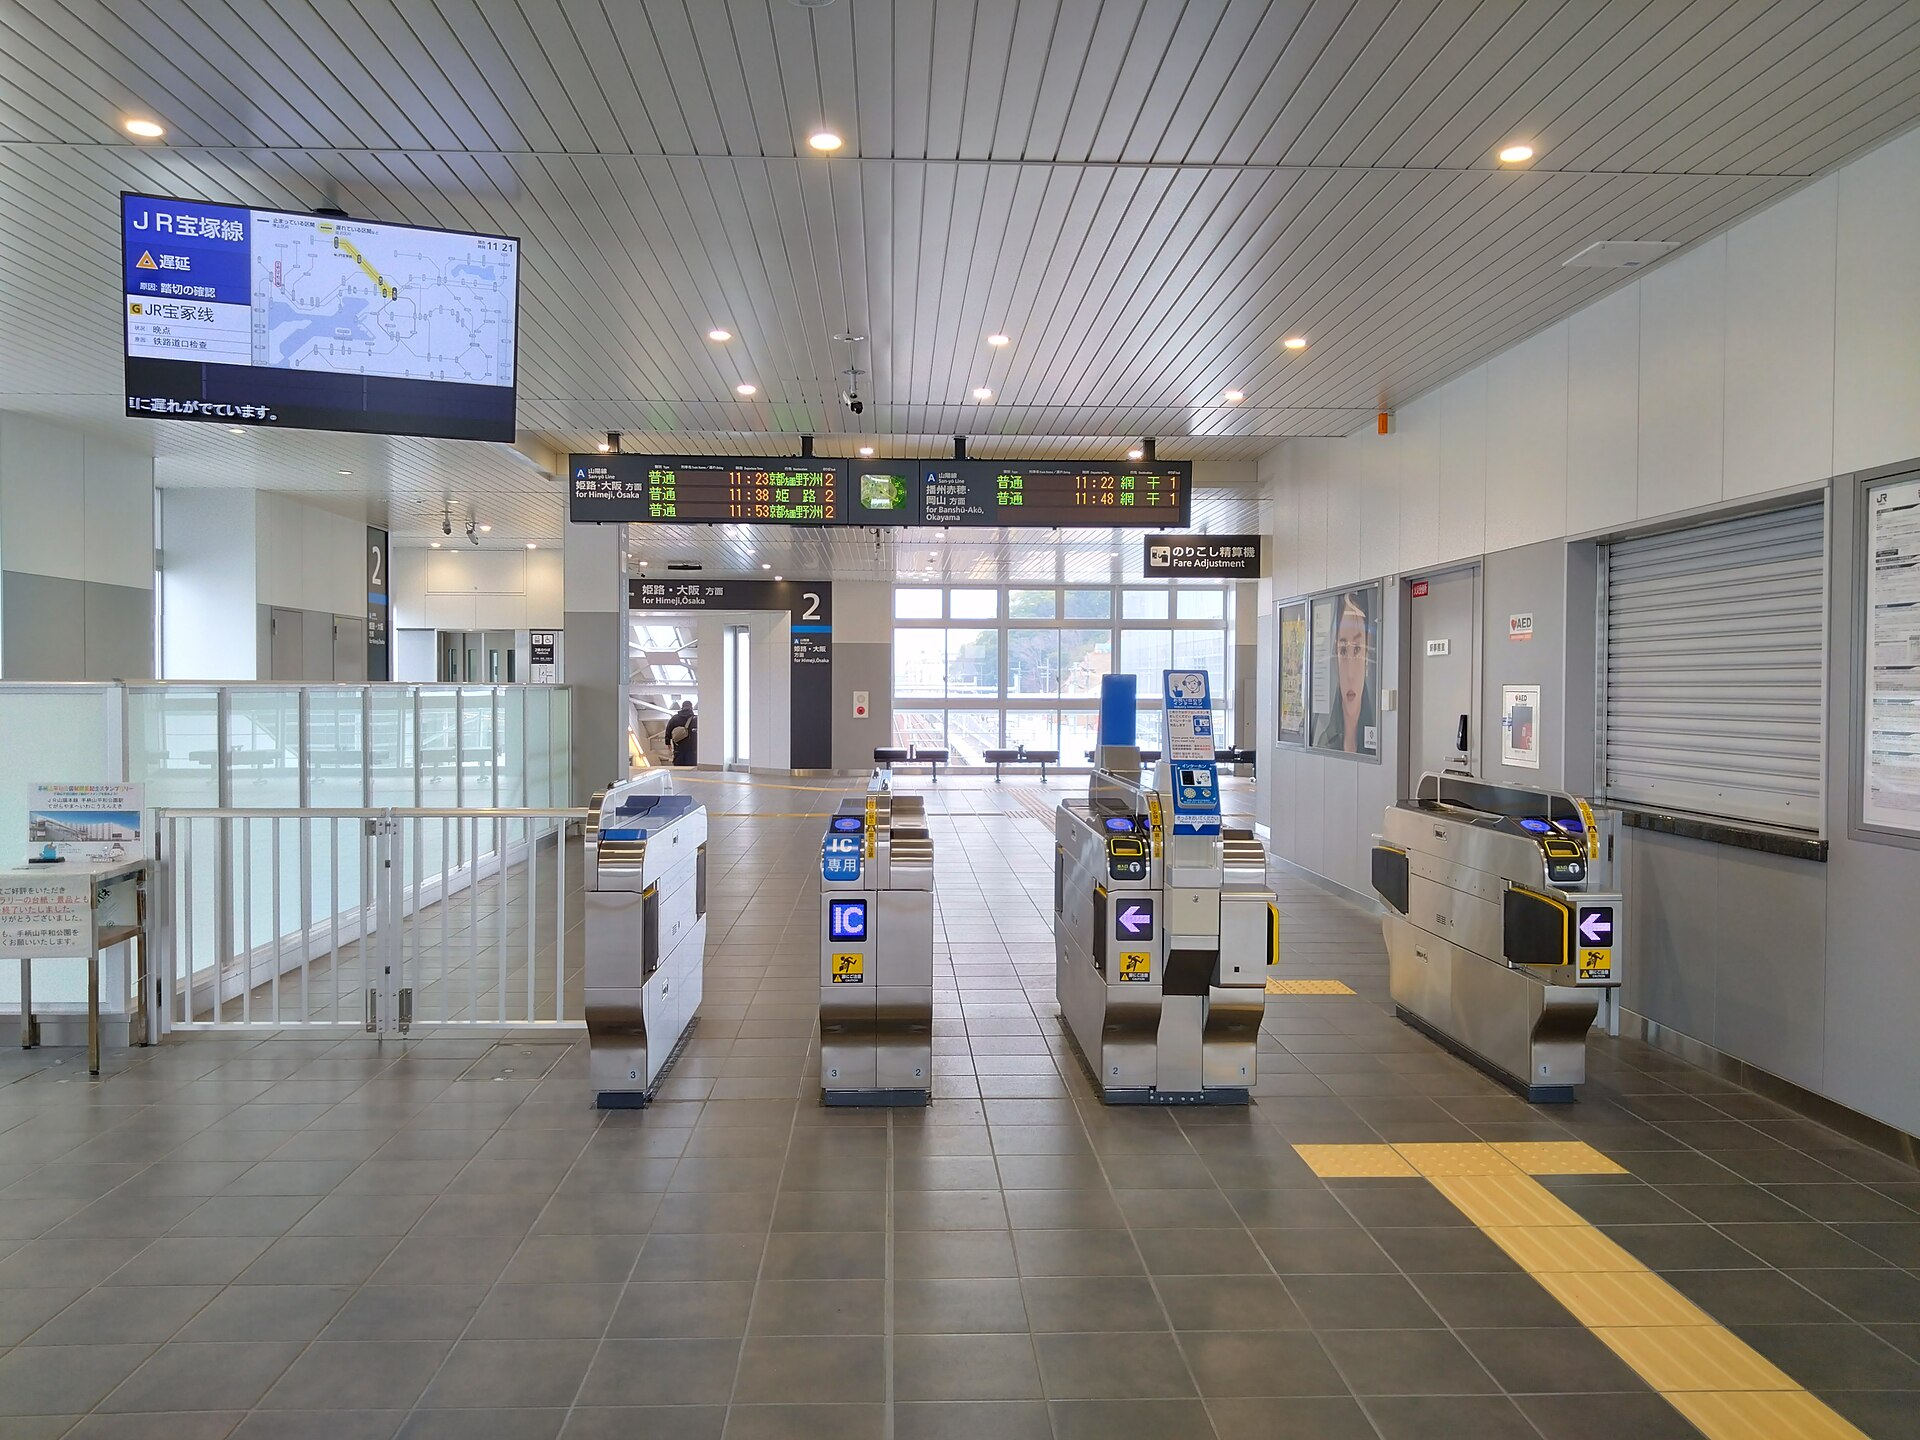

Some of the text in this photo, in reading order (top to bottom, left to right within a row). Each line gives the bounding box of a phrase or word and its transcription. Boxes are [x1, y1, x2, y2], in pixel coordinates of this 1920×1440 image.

[133, 211, 244, 242] JR宝塚線
[487, 241, 513, 252] 11 21
[159, 254, 191, 271] 遅延
[160, 282, 216, 298] 踏切の確認
[132, 304, 141, 314] G
[577, 469, 585, 478] A
[649, 470, 676, 485] 普通
[729, 472, 769, 486] 11:23
[825, 473, 834, 486] 2
[927, 474, 936, 482] A
[575, 480, 642, 491] 姫路・大阪 方面
[996, 475, 1024, 490] 普通
[1075, 476, 1114, 489] 11:22
[1170, 477, 1176, 489] 1
[588, 491, 615, 500] Himeji,
[649, 487, 676, 501] 普通
[729, 488, 769, 502] 11:38
[825, 489, 834, 503] 2
[926, 496, 966, 506] 岡山 方面
[996, 491, 1024, 506] 普通
[1075, 492, 1114, 505] 11:48
[1170, 493, 1176, 505] 1
[1877, 493, 1887, 503] JR
[649, 503, 676, 518] 普通
[729, 504, 769, 518] 11:53
[825, 505, 834, 519] 2
[926, 514, 961, 522] Okayama
[1172, 546, 1256, 558] のりこし精算機
[372, 546, 382, 585] 2
[1173, 559, 1245, 569] Fare Adjustment
[642, 584, 700, 596] 姫路・大阪
[705, 587, 724, 596] 方面
[802, 592, 821, 620] 2
[1516, 617, 1532, 629] AED
[832, 838, 853, 853] IC
[827, 858, 856, 873] 専用
[0, 906, 74, 914] 終了いたしました。
[834, 906, 863, 934] IC
[831, 1069, 838, 1077] 3
[1112, 1067, 1119, 1075] 2
